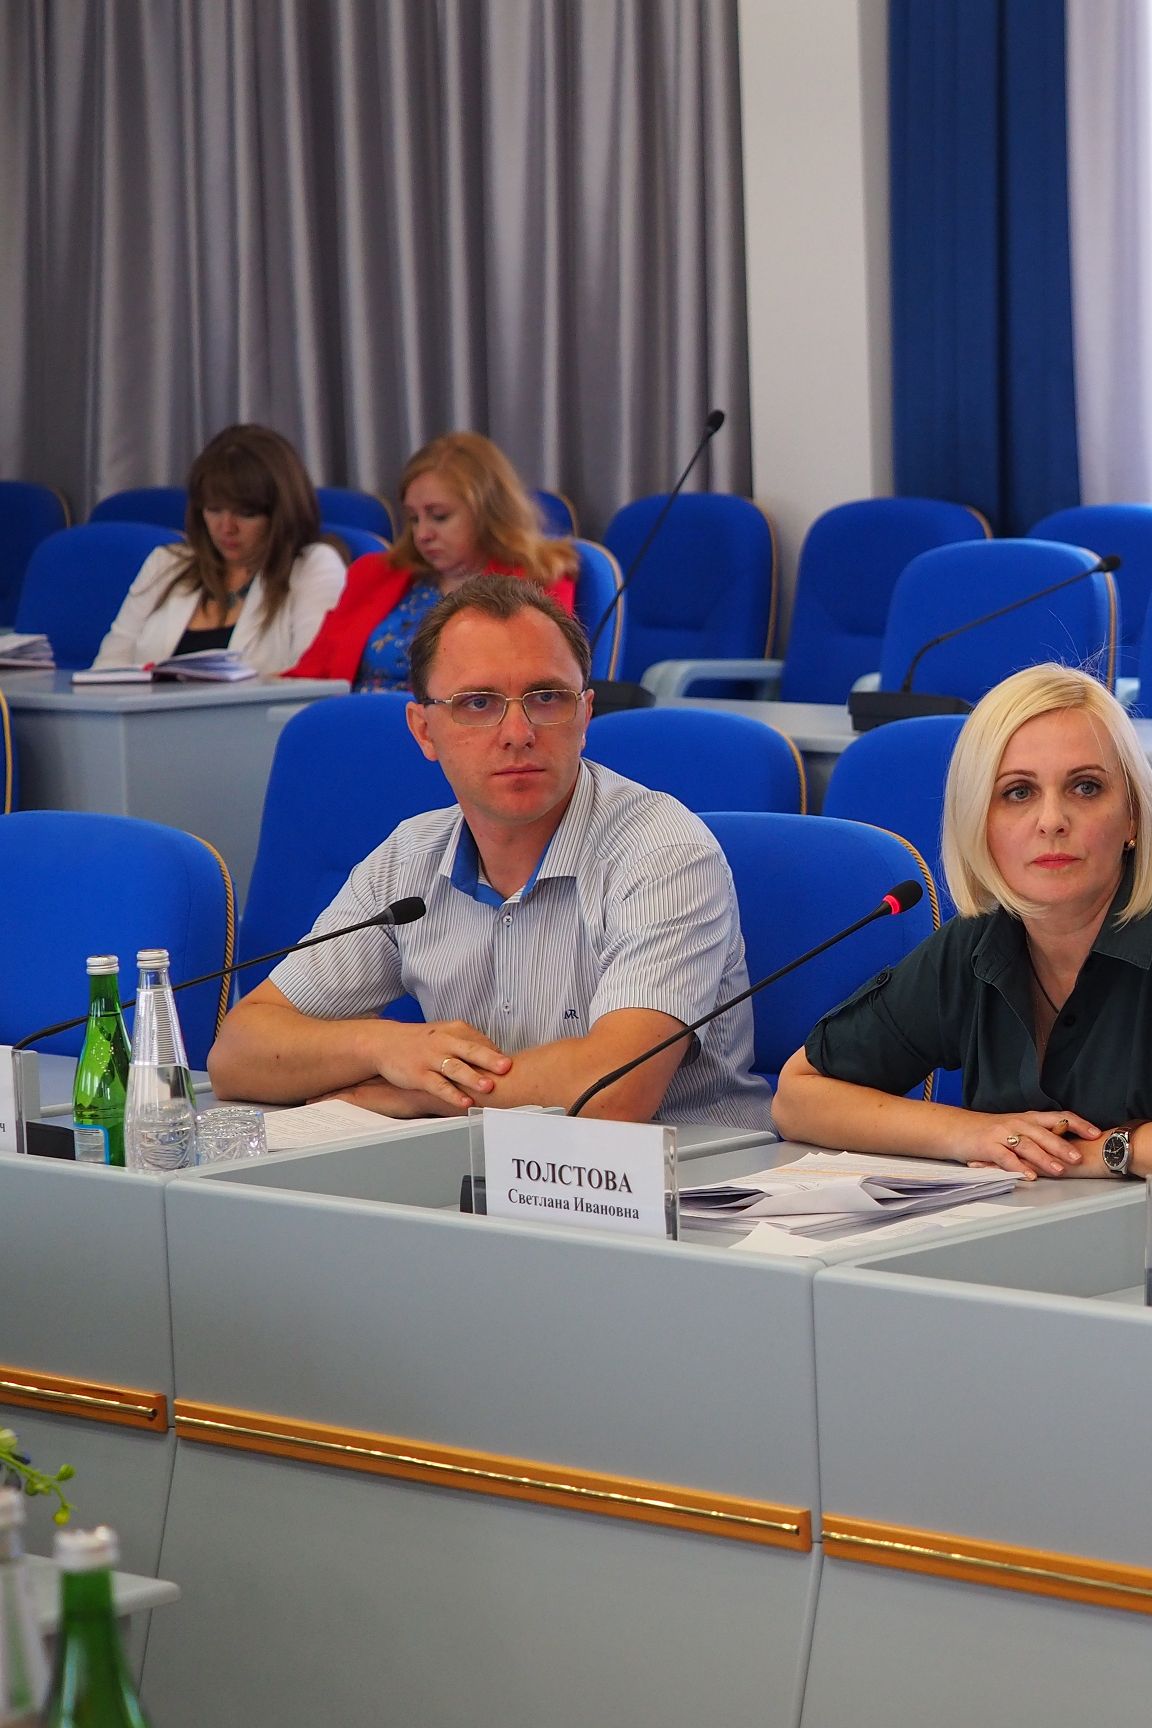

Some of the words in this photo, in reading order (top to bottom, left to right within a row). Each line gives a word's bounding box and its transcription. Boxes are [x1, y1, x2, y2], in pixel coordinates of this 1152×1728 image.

[511, 1158, 632, 1193] ТОЛСТОВА
[508, 1188, 570, 1211] Светлана
[574, 1196, 640, 1220] Ивановна
